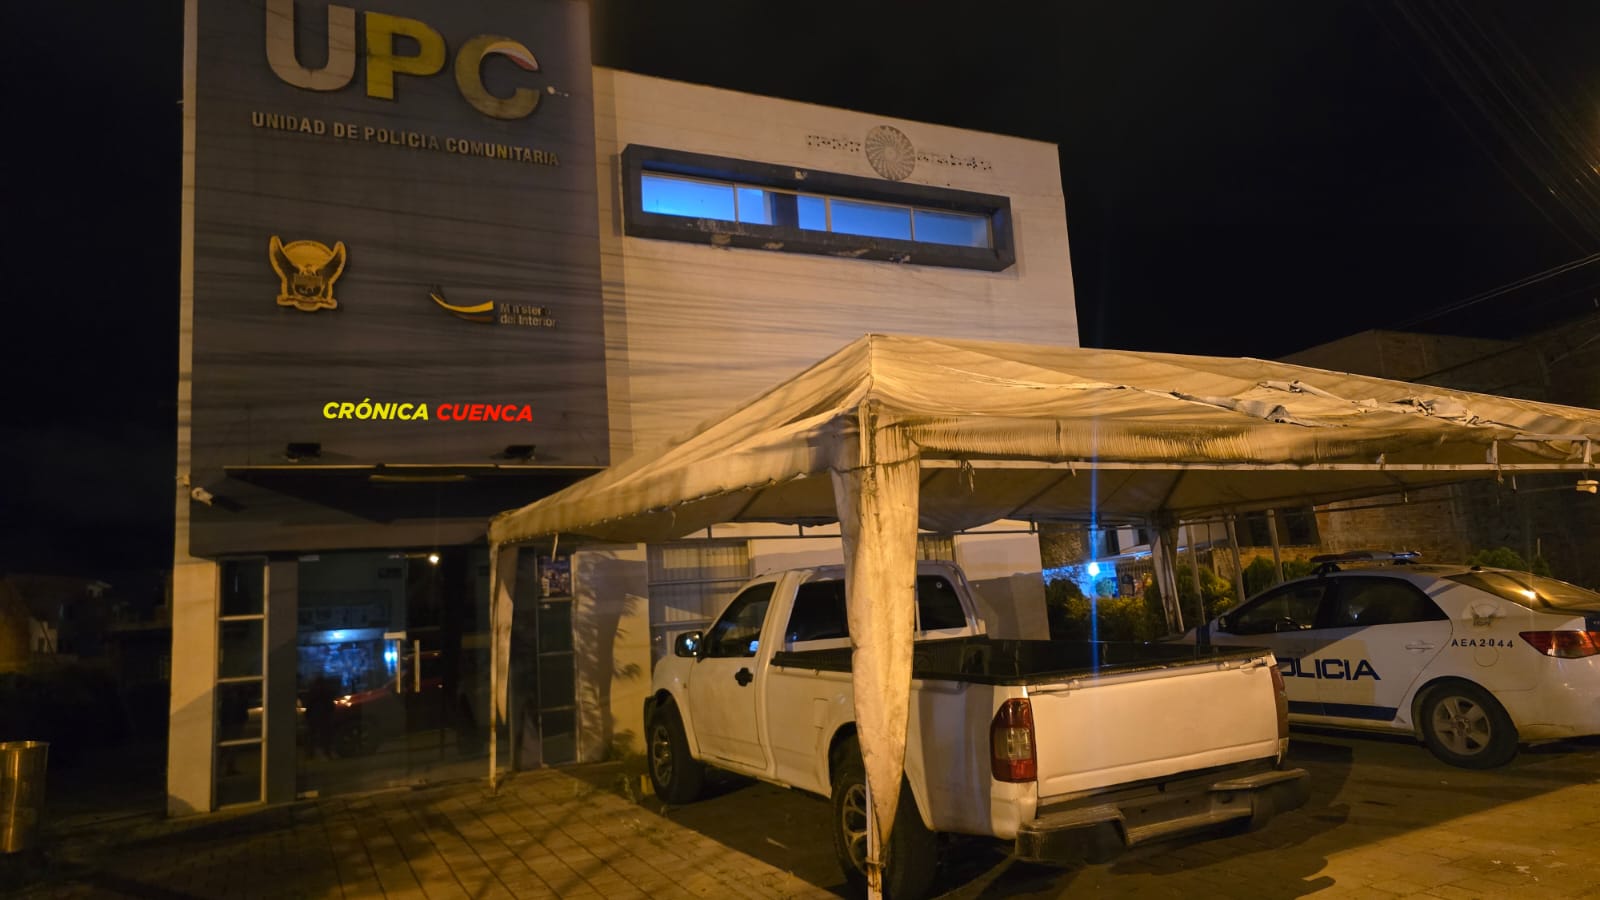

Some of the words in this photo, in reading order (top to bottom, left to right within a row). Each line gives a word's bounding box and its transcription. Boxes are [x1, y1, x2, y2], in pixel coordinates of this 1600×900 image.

[265, 0, 541, 120] UPC
[252, 111, 326, 135] UNIDAD
[333, 121, 359, 139] DE
[364, 126, 440, 150] POLICIA
[446, 137, 560, 166] COMUNITARIA
[1451, 638, 1513, 648] AEA2044
[1278, 657, 1381, 681] OLICIA
